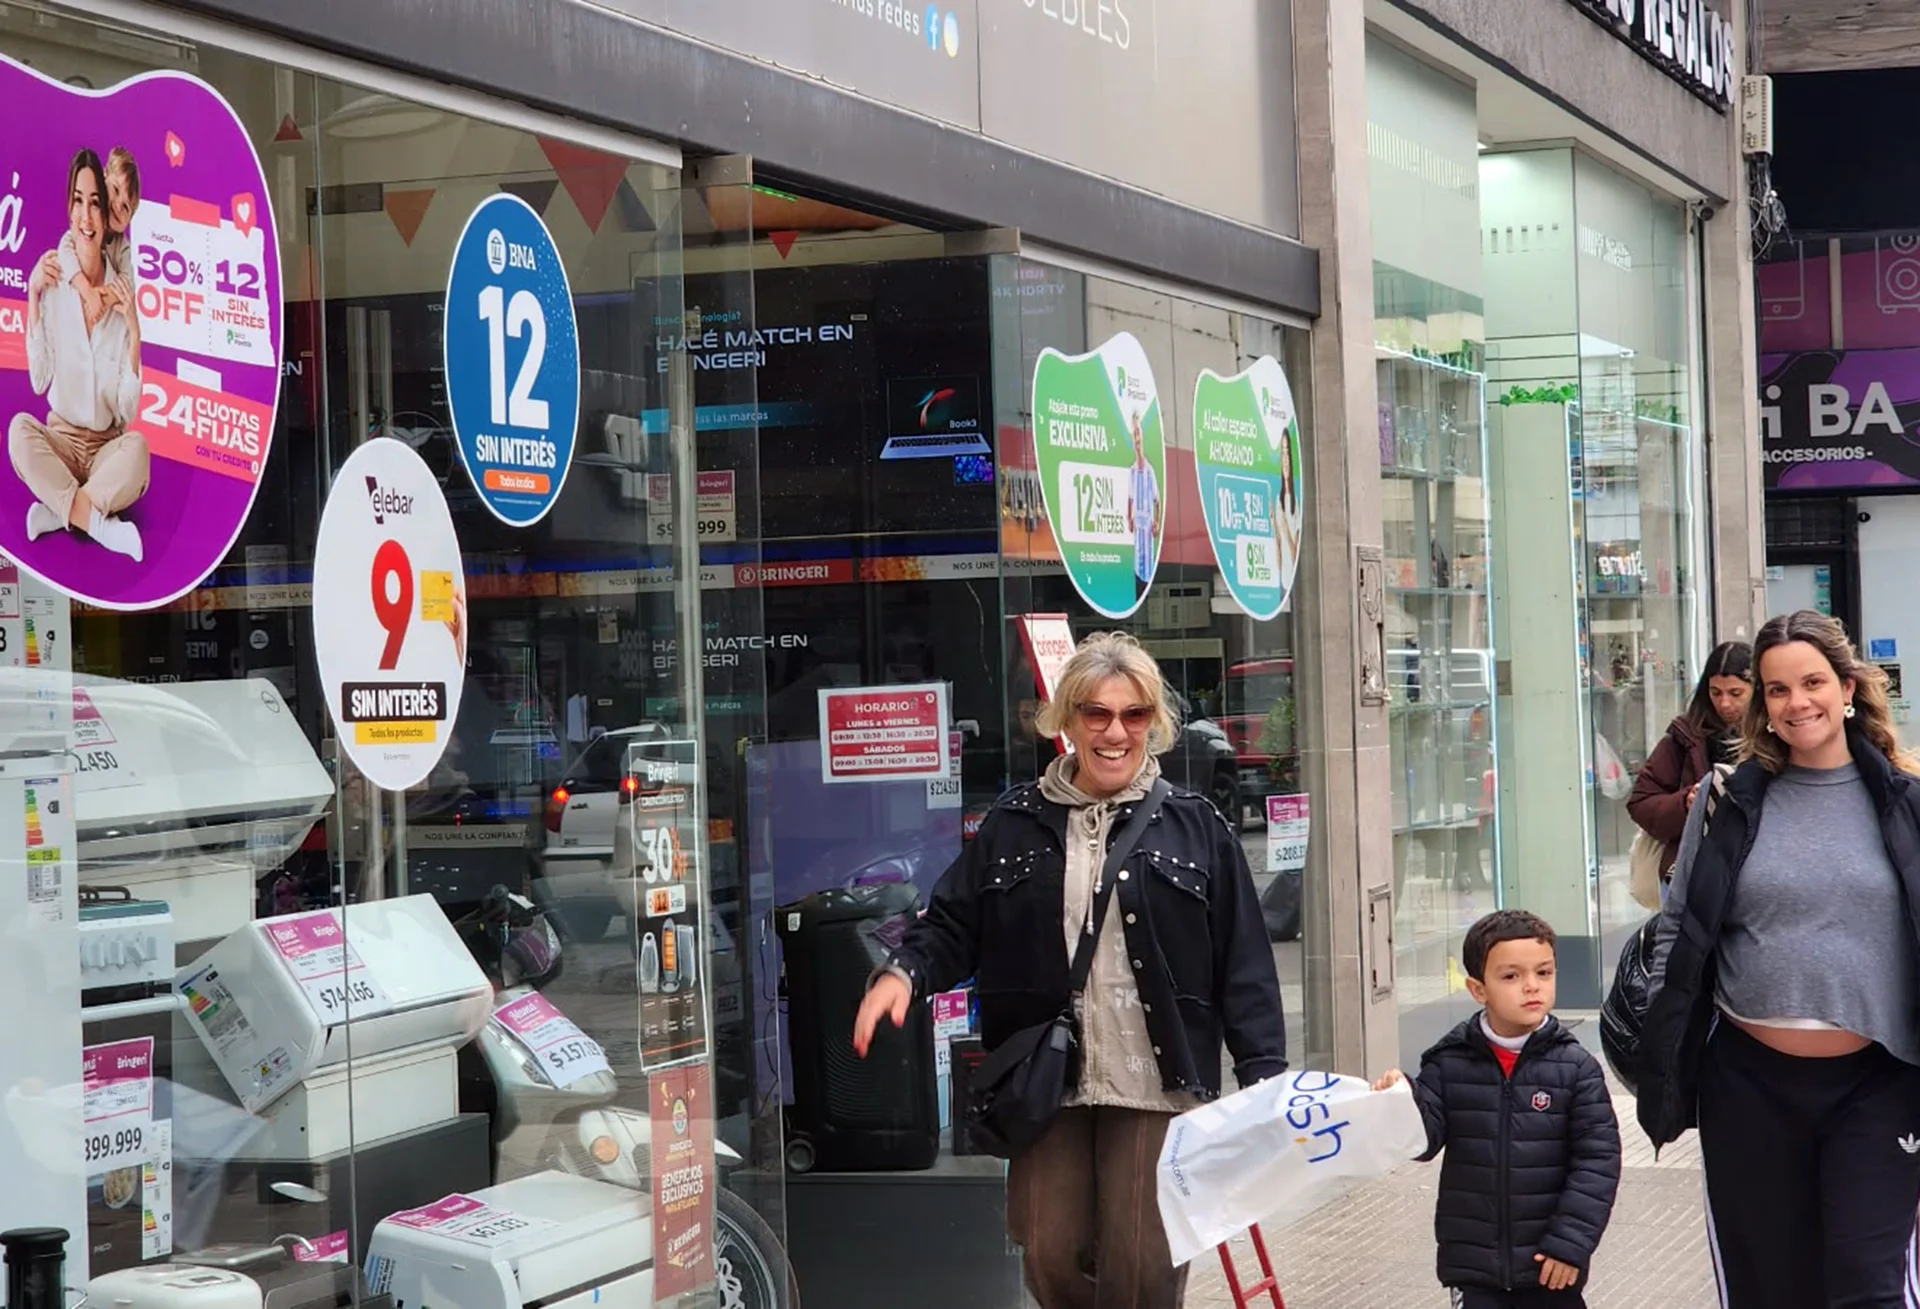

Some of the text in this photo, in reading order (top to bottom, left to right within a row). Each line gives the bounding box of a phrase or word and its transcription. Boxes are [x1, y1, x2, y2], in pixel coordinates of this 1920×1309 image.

[878, 0, 919, 35] redes
[137, 244, 203, 285] 30%
[509, 242, 536, 270] BNA
[0, 267, 28, 293] RE,
[216, 259, 260, 299] 12
[137, 283, 204, 325] OFF
[212, 309, 265, 329] INTERÉS
[228, 298, 249, 313] SIN
[725, 326, 812, 348] MATCH
[819, 323, 854, 342] EN
[478, 285, 549, 430] 12
[656, 351, 766, 373] BNGERI
[141, 383, 196, 436] 24
[195, 397, 260, 431] CUOTAS
[1808, 382, 1905, 437] BA
[196, 418, 260, 457] FIJAS
[476, 434, 556, 469] SIN INTERÉS
[1049, 418, 1108, 452] EXCLUSIVA
[1073, 473, 1095, 532] 12
[1095, 477, 1114, 511] SIN
[757, 565, 829, 581] BRINGERI
[953, 562, 973, 571] NOS
[976, 561, 995, 569] UNE
[1247, 543, 1254, 580] 9
[371, 539, 414, 670] 9
[780, 634, 807, 648] EN
[351, 683, 438, 718] SIN INTERÉS
[855, 701, 910, 713] HORARIO
[369, 728, 386, 739] Todos
[395, 728, 424, 740] productos
[846, 719, 874, 728] LUNES
[883, 717, 920, 727] VIERNES
[465, 833, 476, 841] LA
[662, 1164, 703, 1189] BENEFICIOS
[662, 1180, 704, 1205] EXCLUSIVOS
